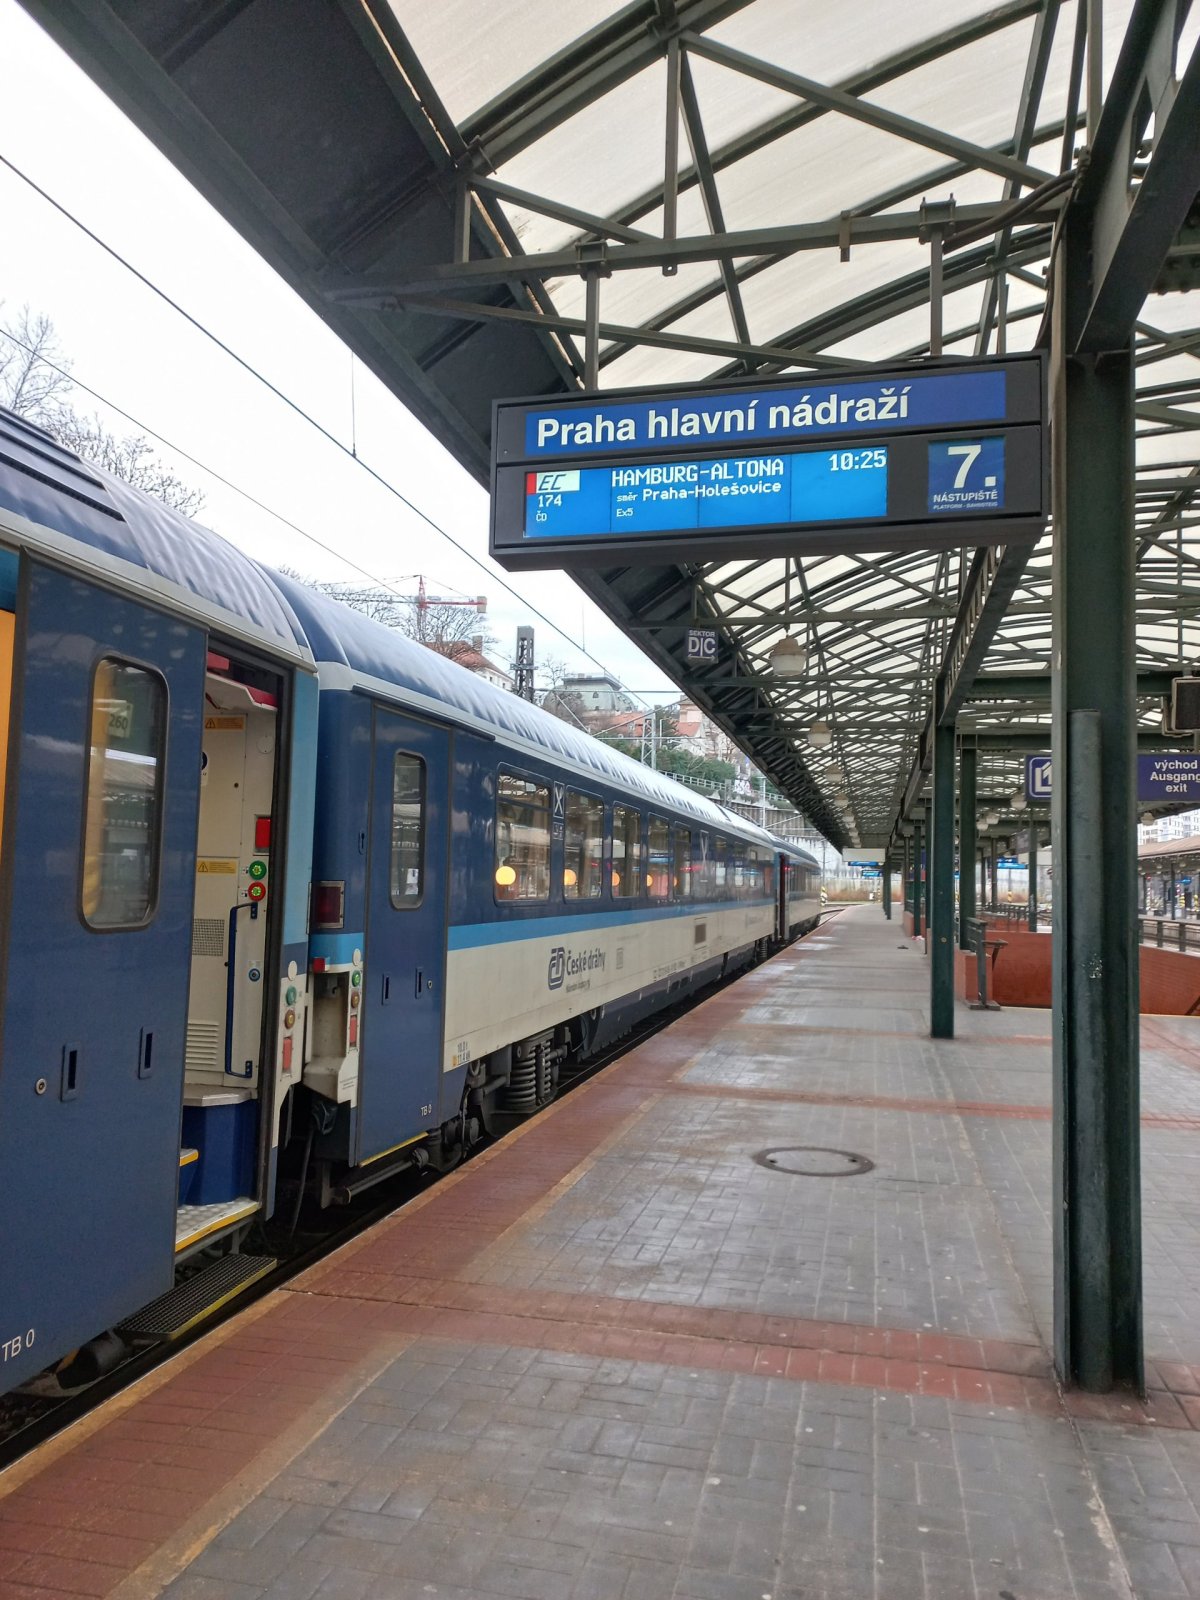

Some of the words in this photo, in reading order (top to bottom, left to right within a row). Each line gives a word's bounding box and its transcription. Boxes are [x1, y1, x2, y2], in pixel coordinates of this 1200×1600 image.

[537, 414, 636, 447] Praha
[648, 400, 759, 439] hlavní
[769, 385, 912, 429] nádraží
[828, 450, 887, 472] 10:25
[947, 444, 997, 489] 7.
[611, 458, 784, 488] HAMBURG-ALTONA
[537, 473, 567, 491] EC
[643, 480, 782, 501] Praha-Holešovice
[933, 489, 998, 503] NÁSTUPIŠTĚ
[537, 493, 563, 508] 174
[535, 510, 548, 522] ČD
[616, 507, 634, 517] Ex5
[689, 629, 716, 637] SEKTOR
[109, 713, 129, 729] 260
[1154, 759, 1198, 771] východ
[1150, 771, 1200, 783] Ausgang
[1165, 783, 1188, 793] exit
[566, 949, 587, 976] České
[588, 947, 606, 972] dráhy
[1, 1335, 21, 1362] TB
